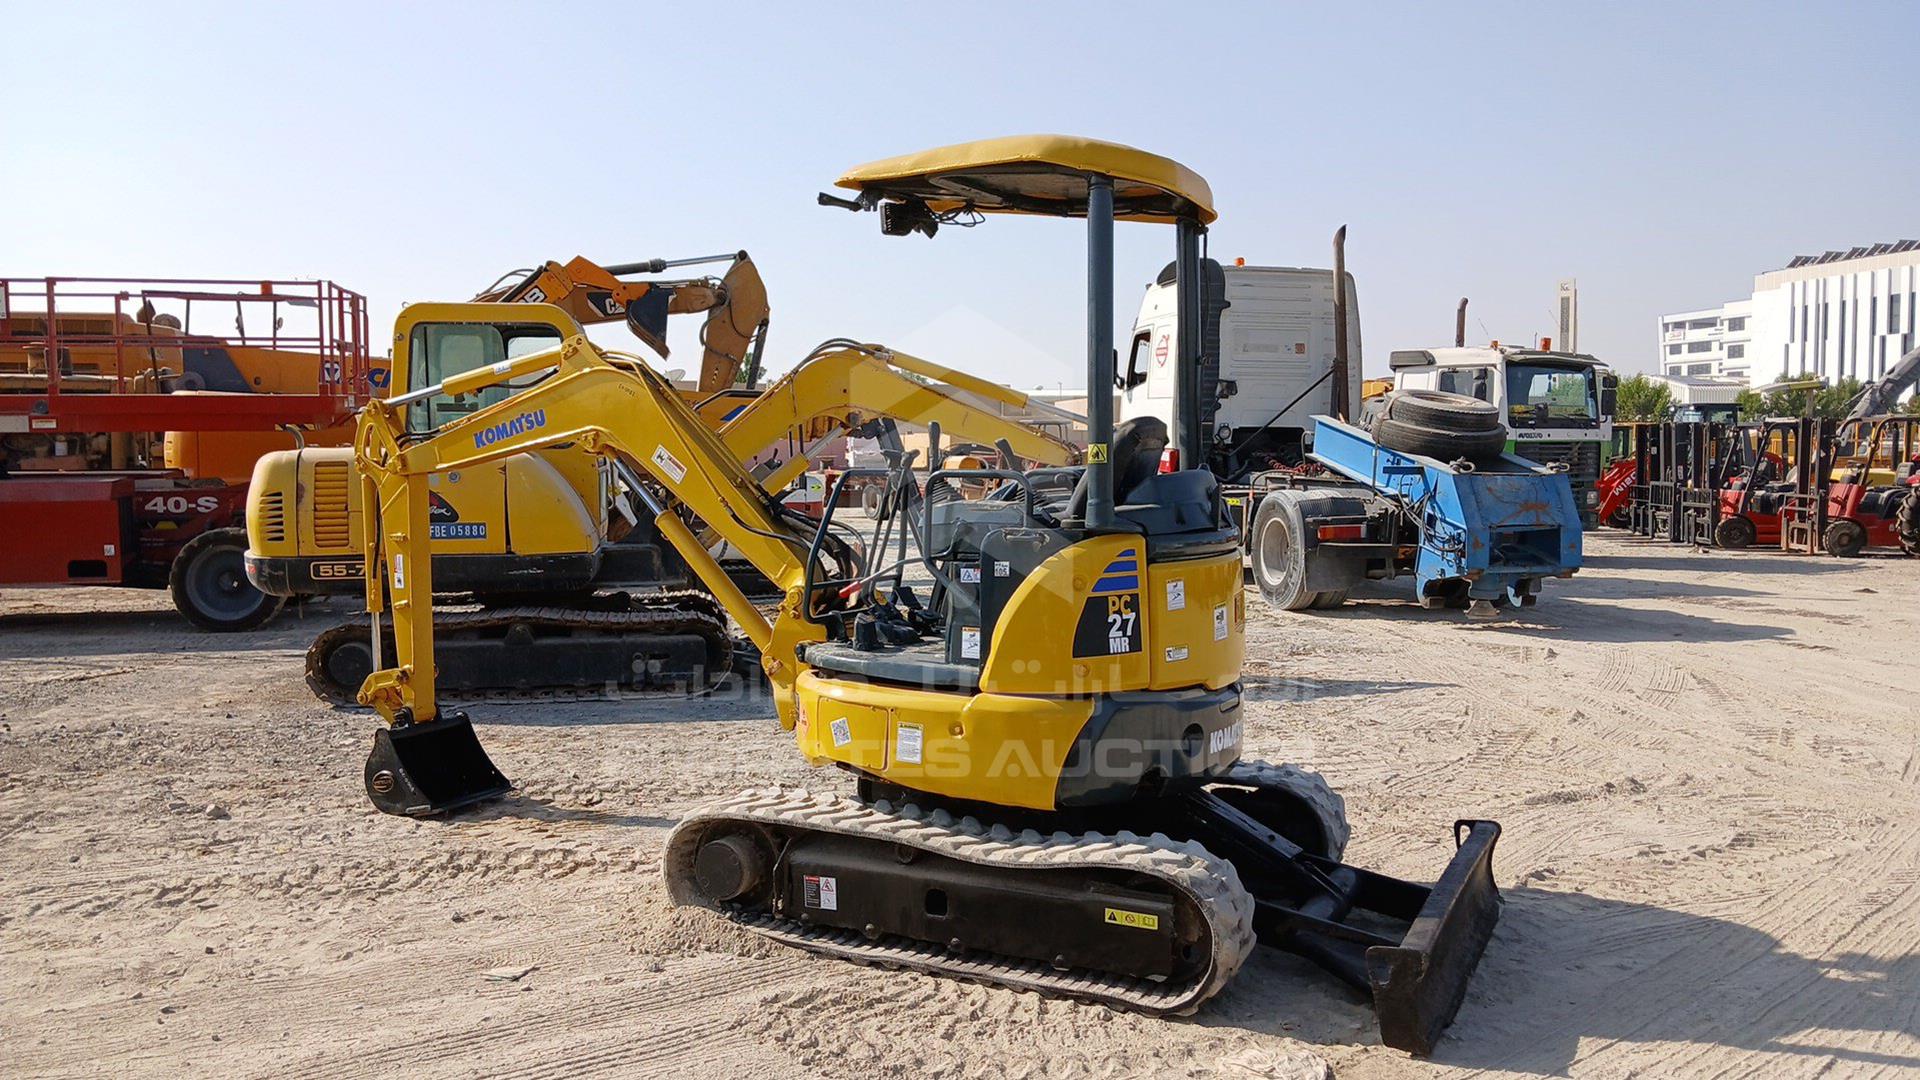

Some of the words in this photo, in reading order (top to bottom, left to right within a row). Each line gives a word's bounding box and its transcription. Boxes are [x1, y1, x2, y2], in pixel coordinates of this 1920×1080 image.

[473, 409, 547, 448] KOMATSU
[144, 496, 219, 514] 40-S
[450, 525, 486, 537] 05880
[1108, 594, 1133, 616] PC
[1107, 612, 1137, 638] 27
[1109, 637, 1130, 654] MR
